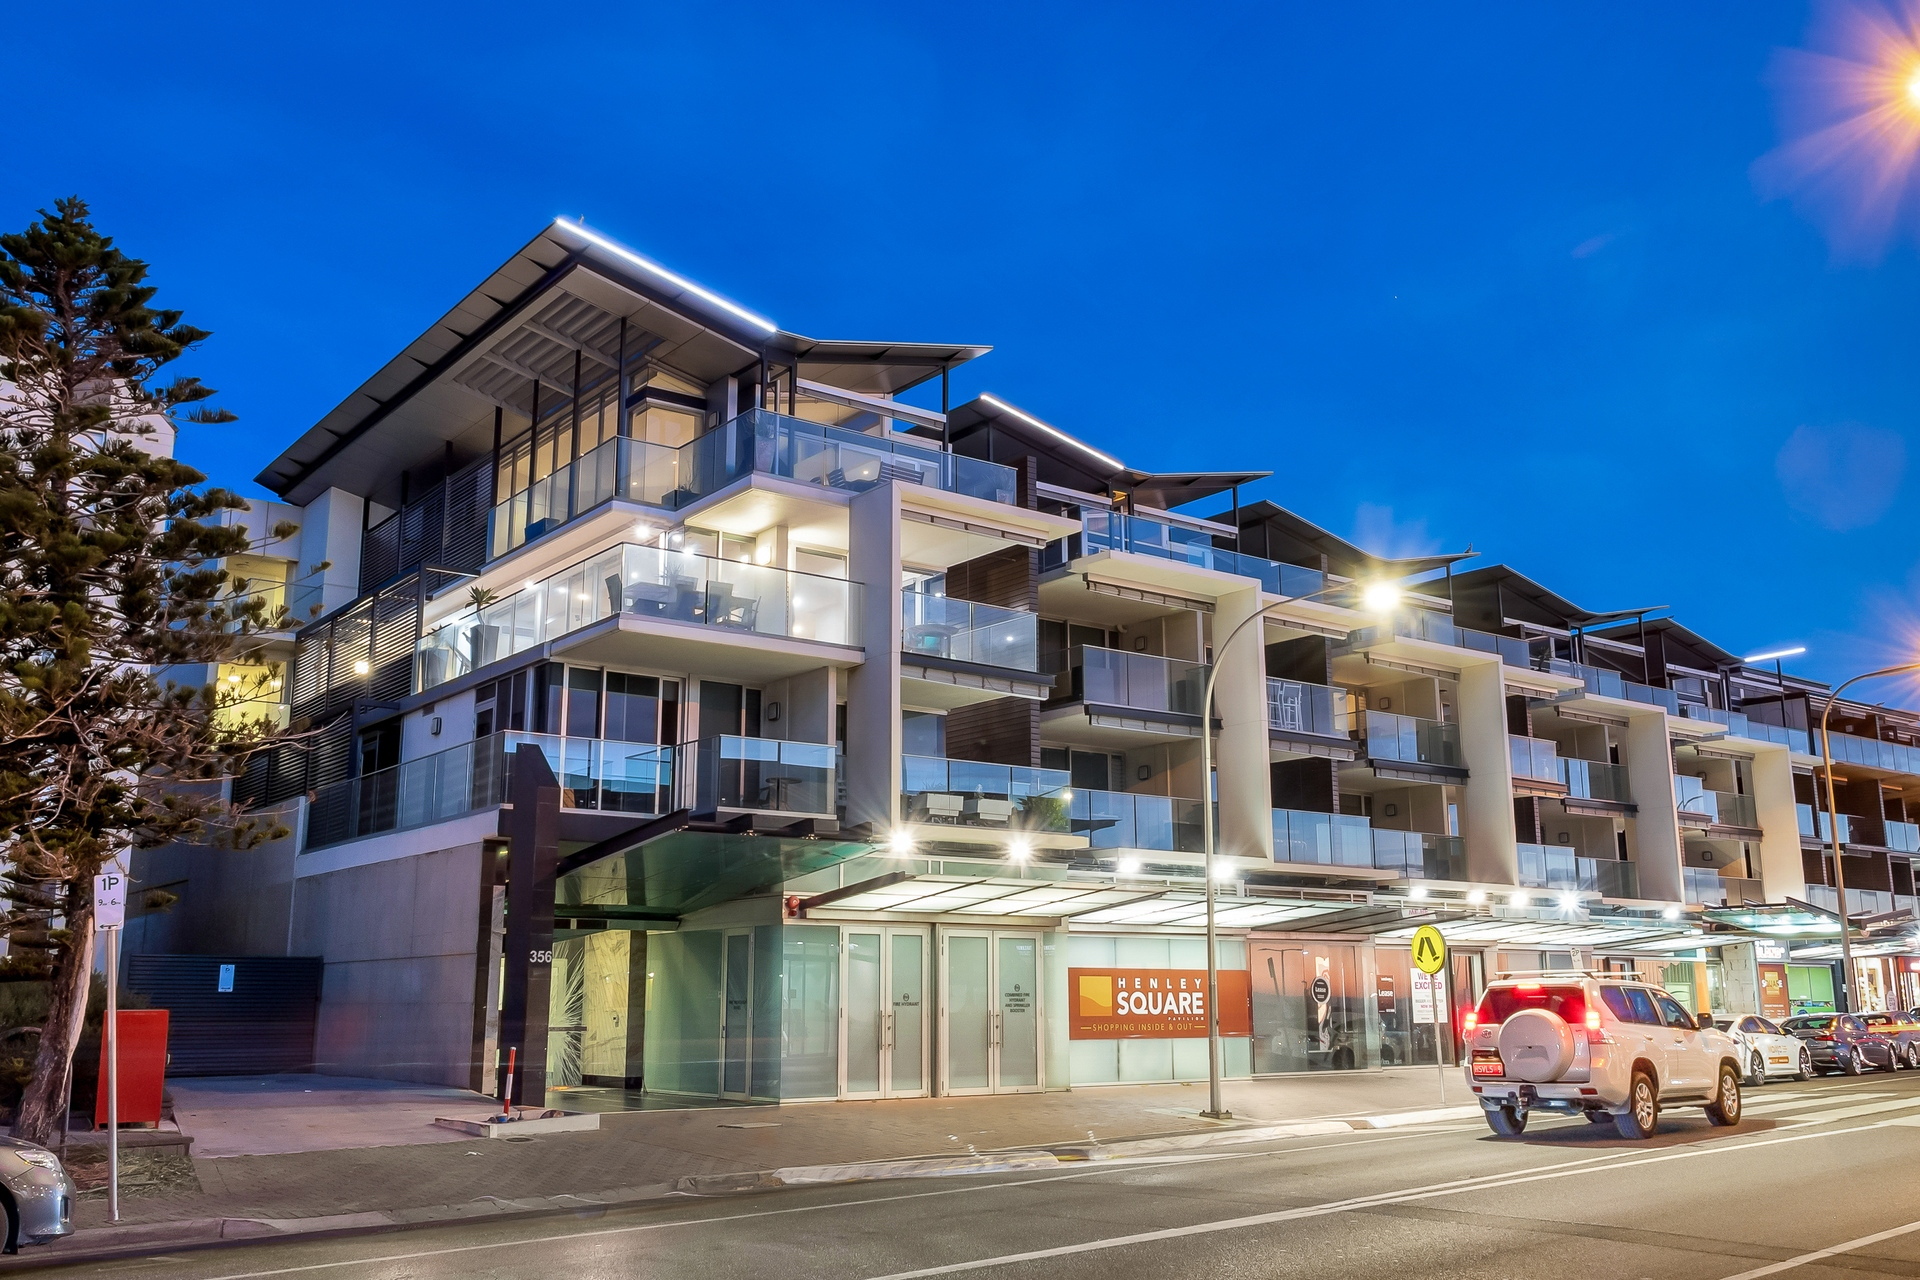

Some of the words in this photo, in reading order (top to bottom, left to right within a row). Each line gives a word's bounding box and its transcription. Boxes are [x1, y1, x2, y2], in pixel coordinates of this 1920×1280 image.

[101, 876, 119, 891] 1P
[529, 950, 552, 963] 356
[1118, 977, 1202, 989] HENLEY
[1378, 989, 1394, 997] Lease
[1117, 991, 1204, 1015] SQUARE
[1092, 1023, 1135, 1032] SHOPPING
[1138, 1023, 1165, 1031] INSIDE
[1168, 1023, 1174, 1031] &
[1176, 1023, 1193, 1031] OUT
